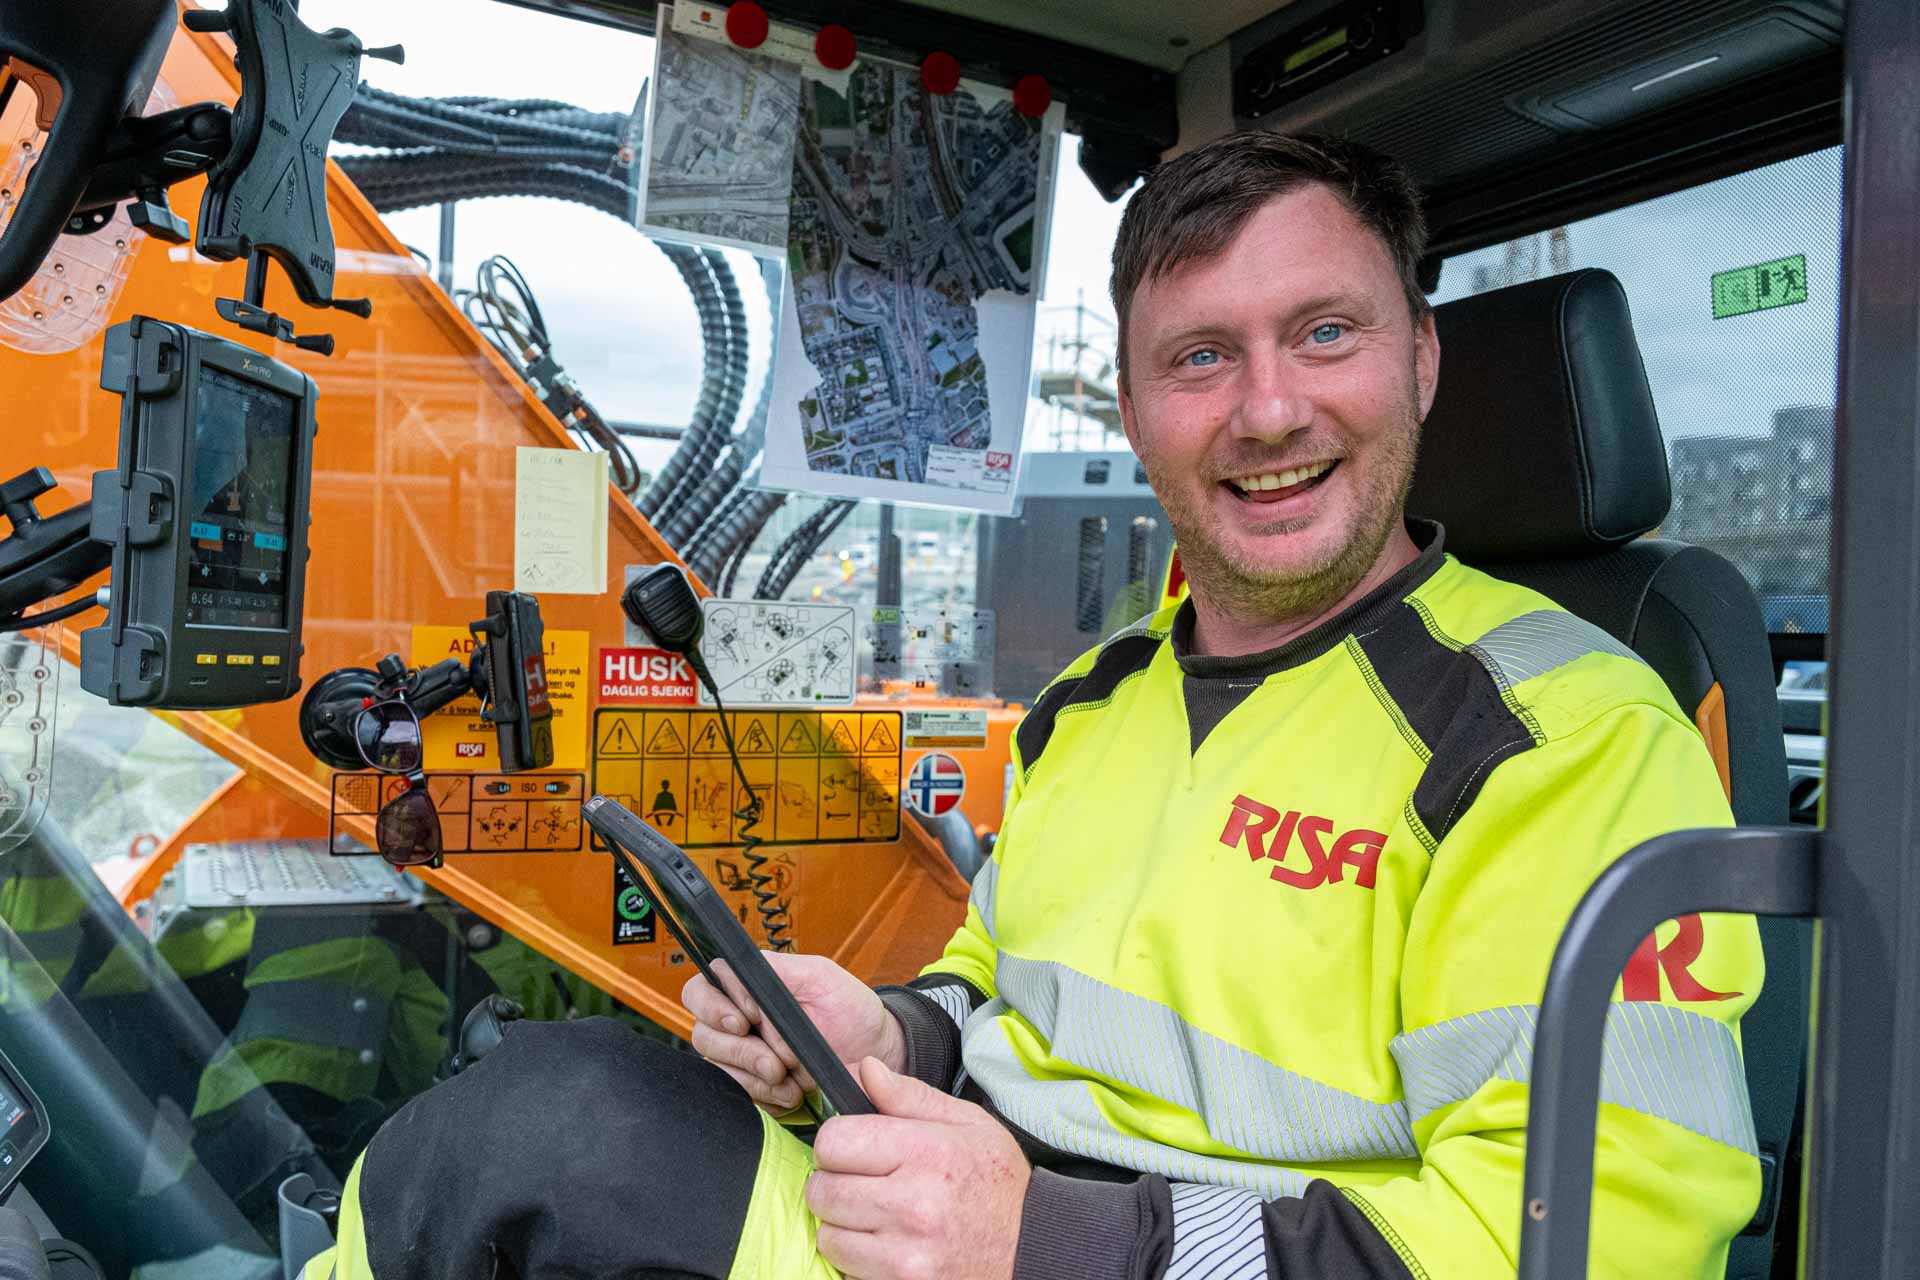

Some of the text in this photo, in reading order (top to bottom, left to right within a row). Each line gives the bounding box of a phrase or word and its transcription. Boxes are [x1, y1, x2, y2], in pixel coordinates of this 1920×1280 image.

[988, 454, 1009, 468] RISA
[605, 655, 690, 682] HUSK
[602, 685, 694, 697] DAGLIG SJEKK!
[458, 743, 483, 756] RISA
[521, 783, 537, 793] ISO
[1219, 794, 1389, 890] RISA
